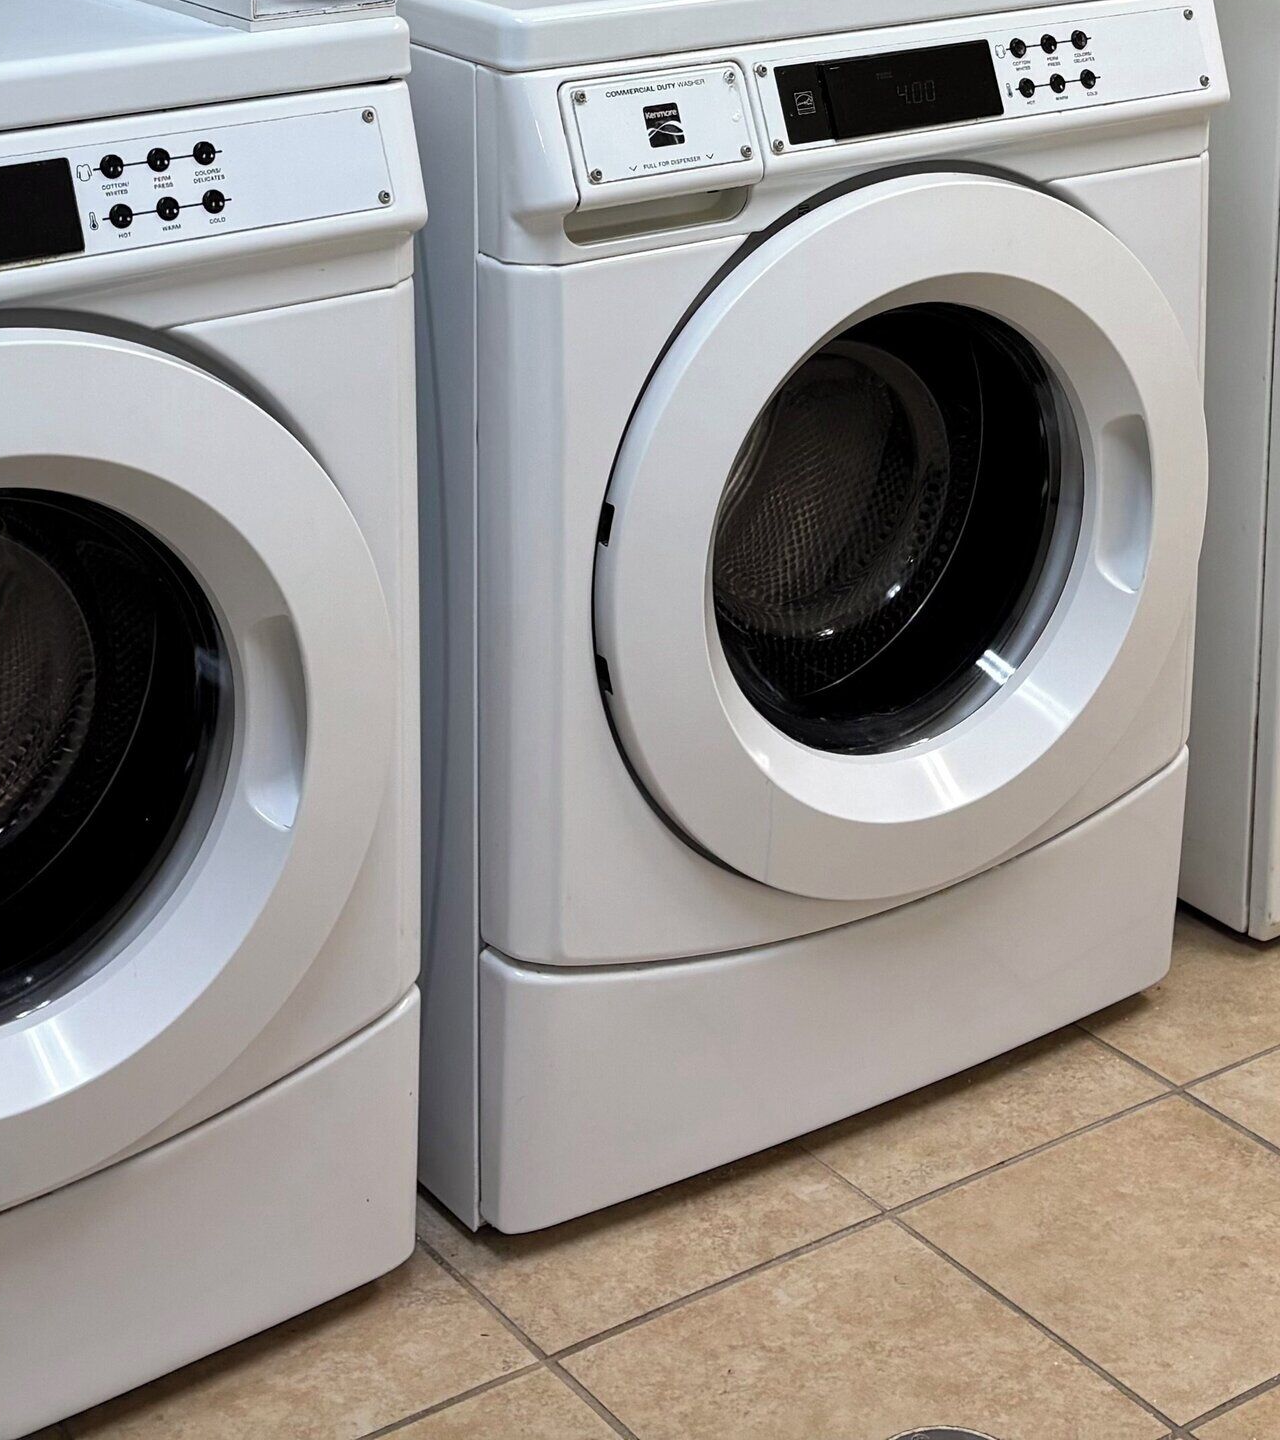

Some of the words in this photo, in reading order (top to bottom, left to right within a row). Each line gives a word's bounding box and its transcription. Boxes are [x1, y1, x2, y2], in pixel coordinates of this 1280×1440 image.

[605, 85, 655, 98] COMMERCIAL
[656, 82, 676, 91] DUTY
[677, 78, 706, 88] WASHER
[645, 108, 677, 120] Kenmore
[658, 159, 669, 167] FOR
[670, 155, 701, 166] DISPENSER
[194, 168, 222, 177] COLORS/
[193, 174, 226, 185] DELICATES
[153, 182, 174, 190] PRESS
[105, 189, 129, 197] WHITES
[209, 216, 226, 224] COLD
[162, 224, 182, 232] WARM
[118, 231, 132, 239] HOT
